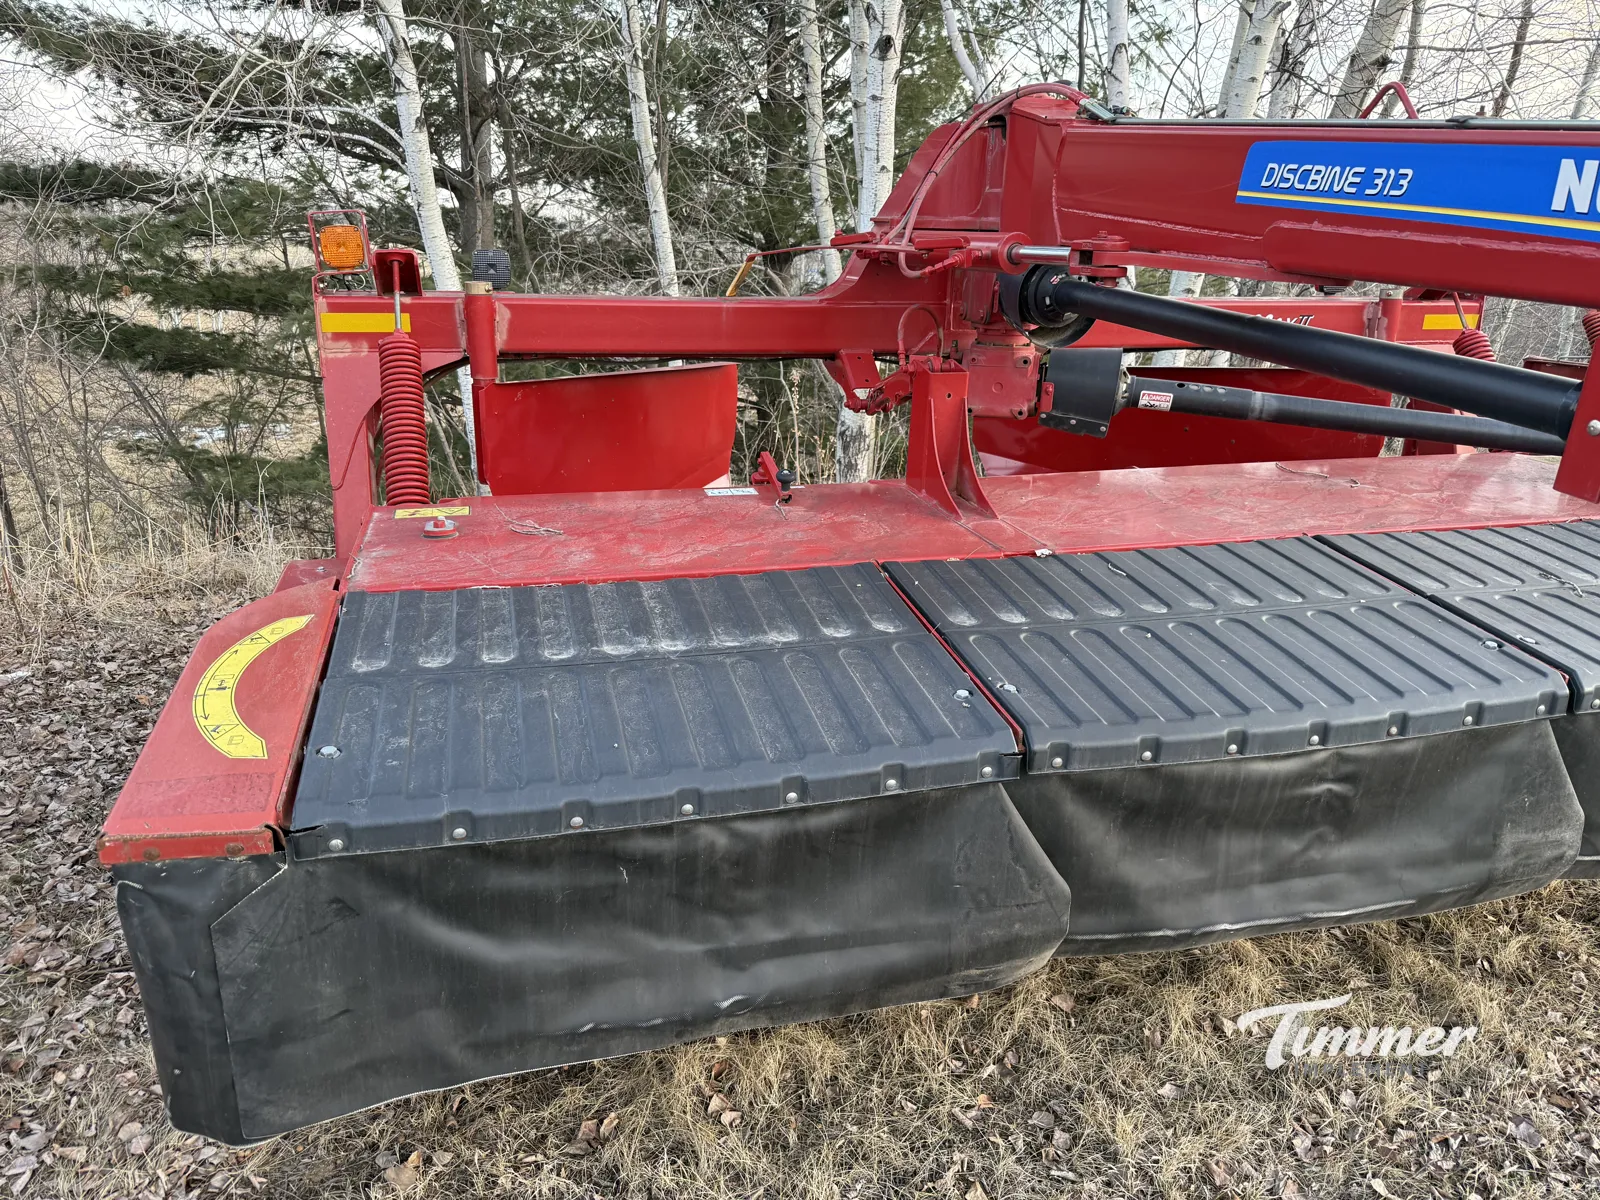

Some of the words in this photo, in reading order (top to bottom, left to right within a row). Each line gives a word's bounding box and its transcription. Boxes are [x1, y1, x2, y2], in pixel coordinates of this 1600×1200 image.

[1260, 163, 1366, 194] DISCBINE
[1364, 168, 1414, 197] 313
[1550, 158, 1600, 214] N
[1149, 394, 1171, 403] DANGER
